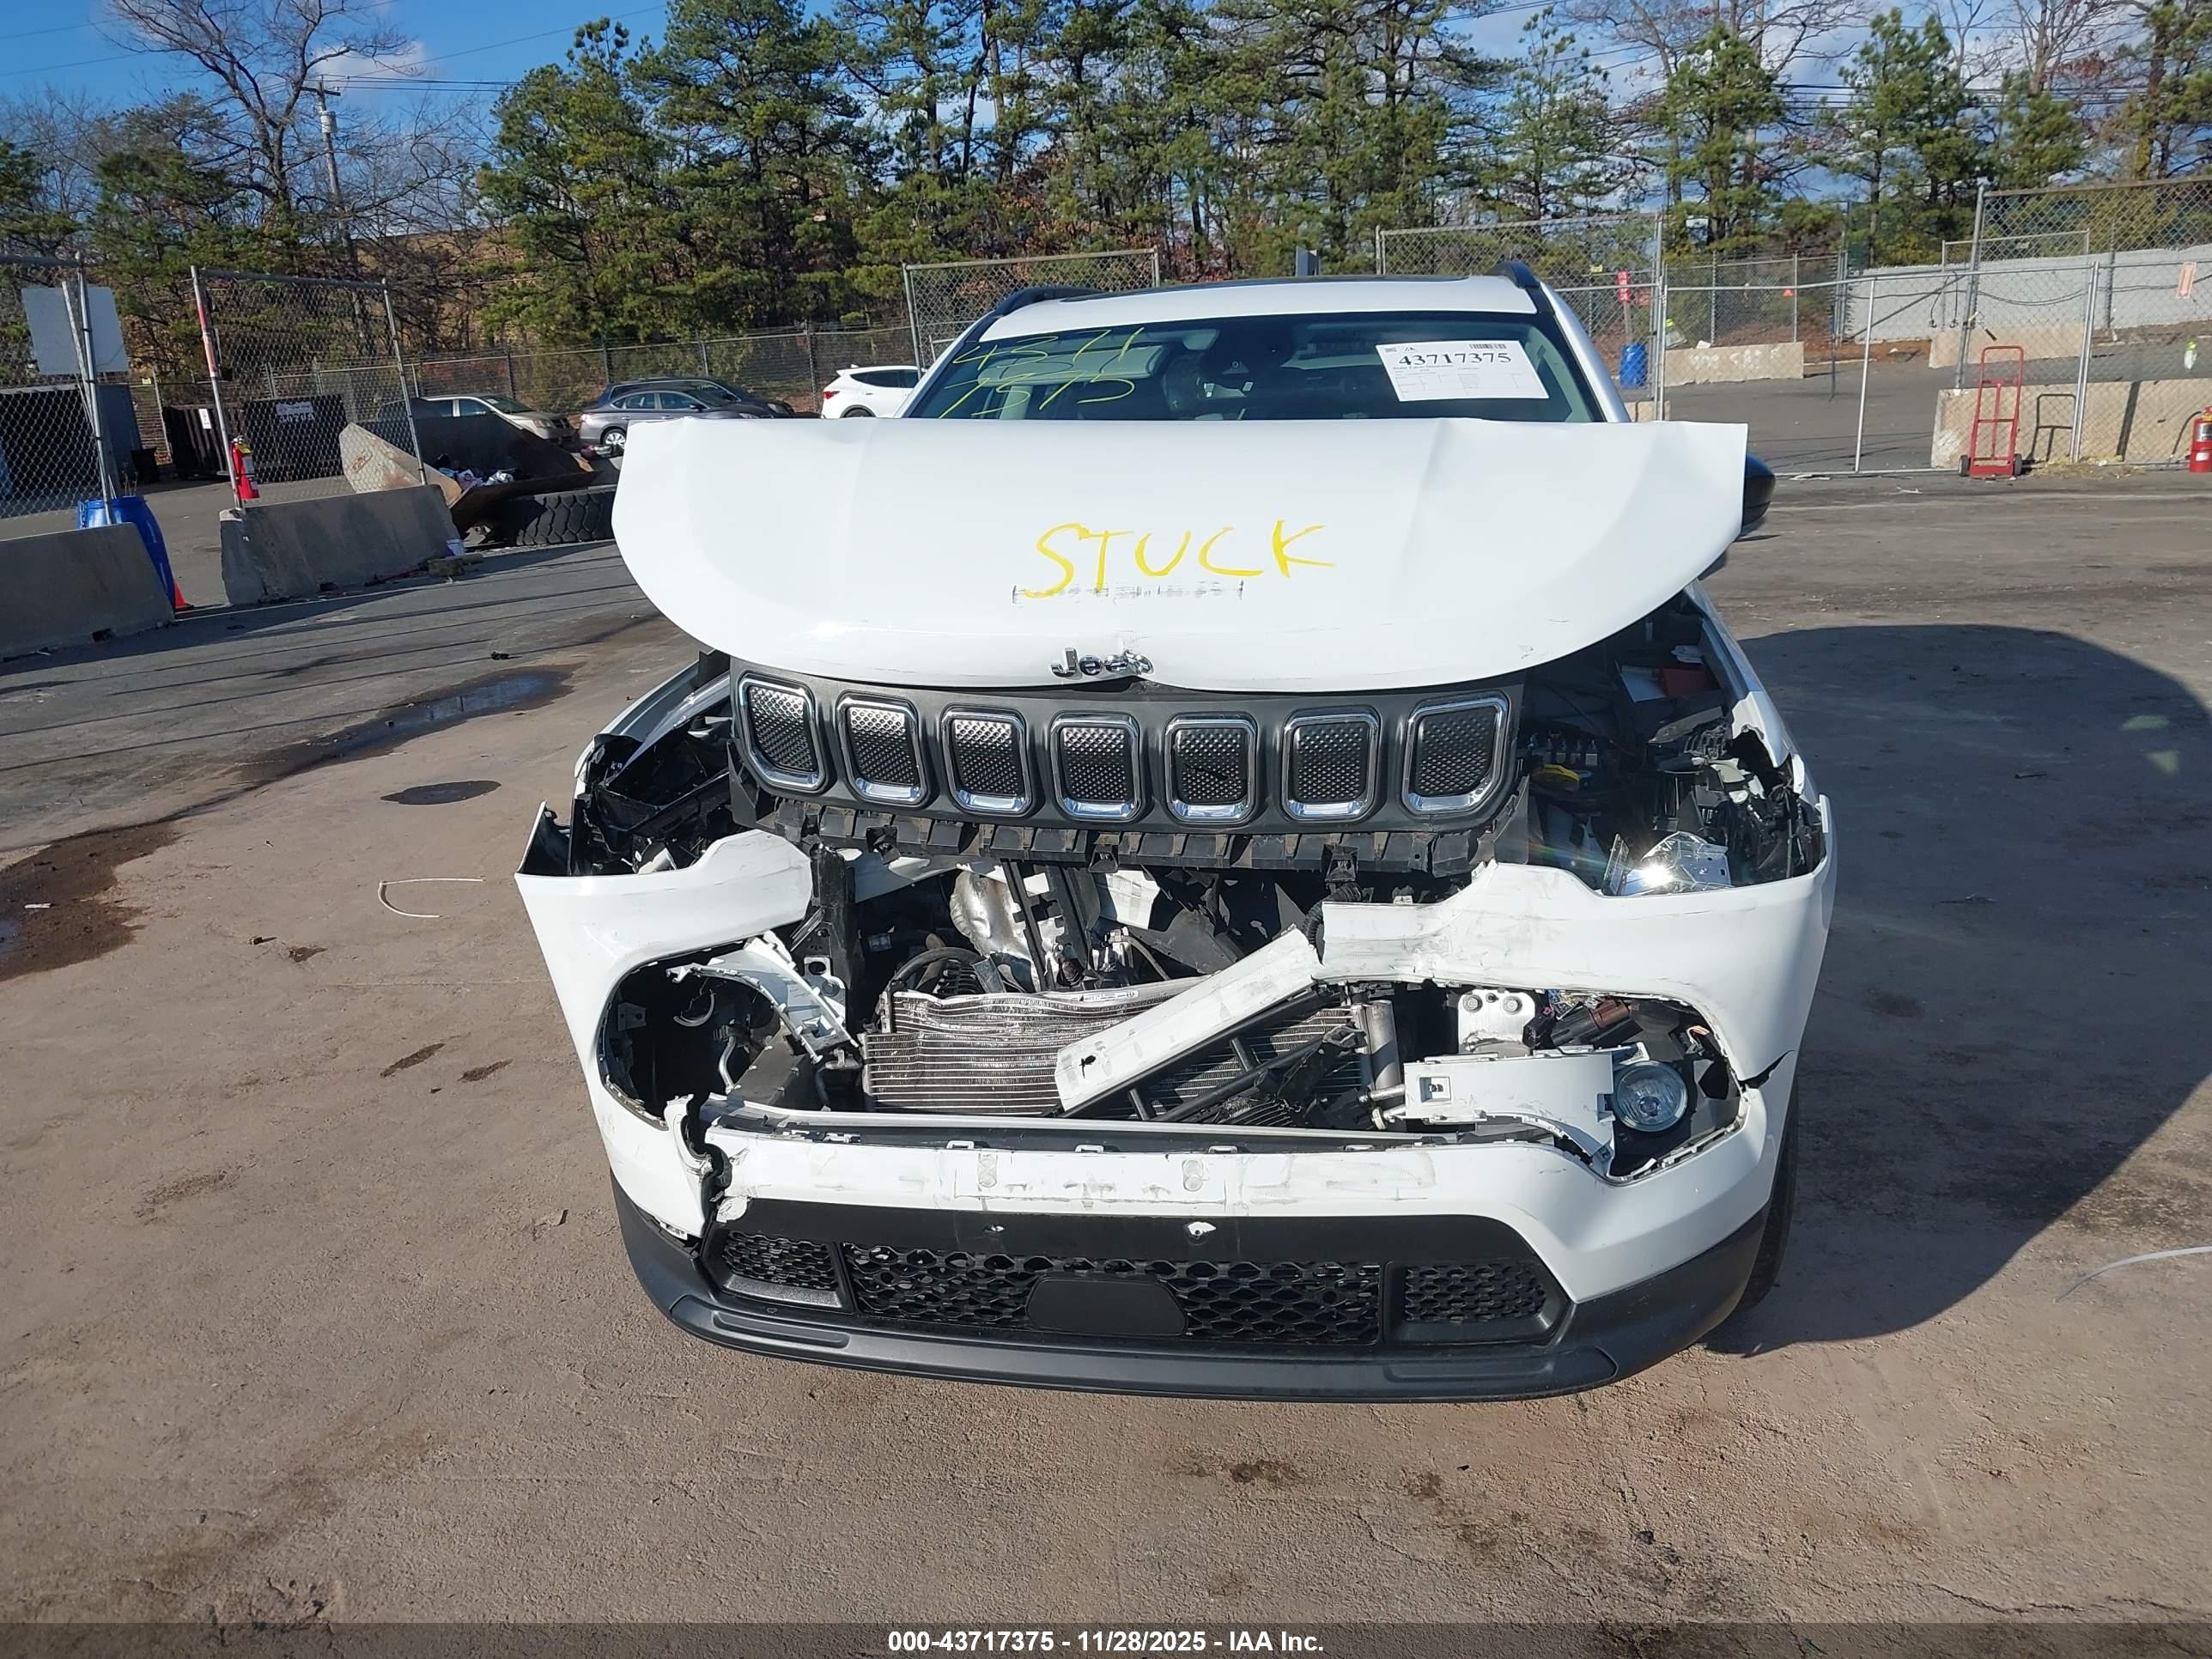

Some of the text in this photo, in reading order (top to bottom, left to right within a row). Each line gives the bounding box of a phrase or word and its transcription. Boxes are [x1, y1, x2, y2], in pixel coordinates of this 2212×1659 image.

[1398, 352, 1512, 366] 43717375
[1024, 519, 1336, 599] STUCK
[1049, 646, 1155, 679] Jeep
